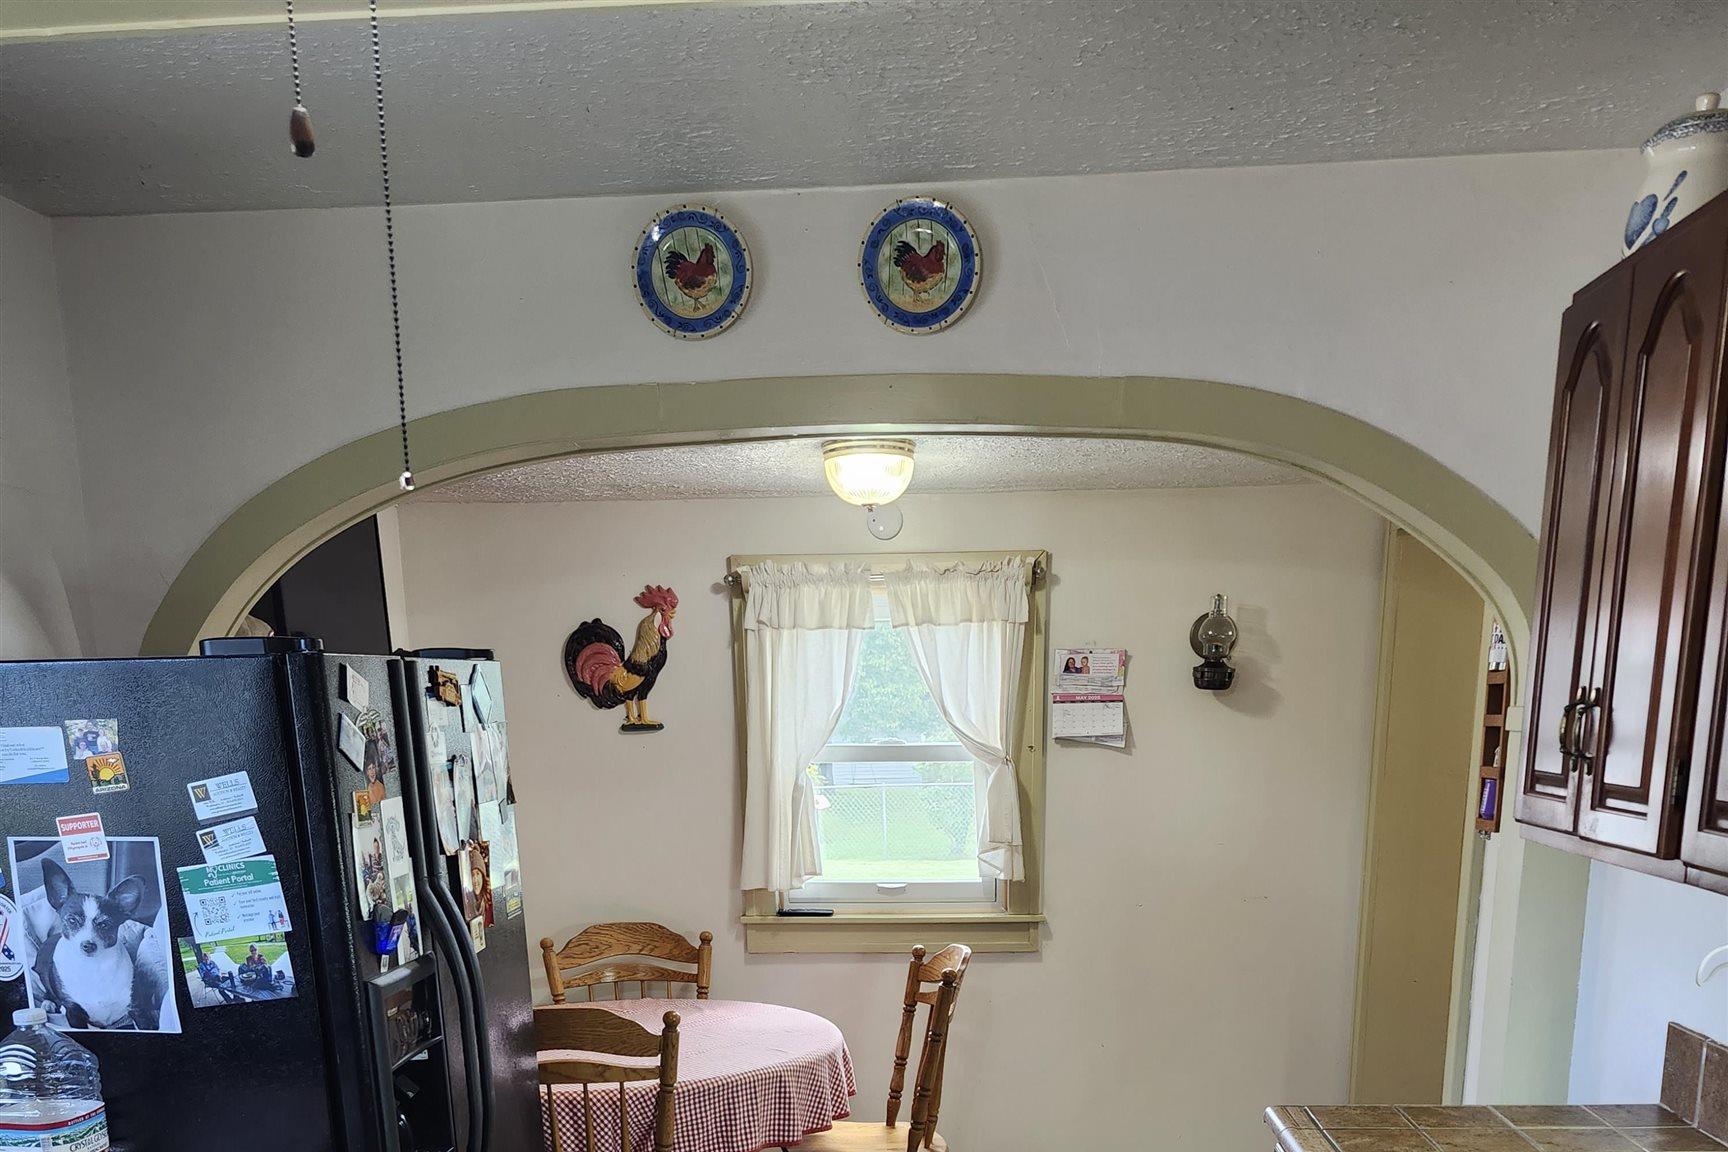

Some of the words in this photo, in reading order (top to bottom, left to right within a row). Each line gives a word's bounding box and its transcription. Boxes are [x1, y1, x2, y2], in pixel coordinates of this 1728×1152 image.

[95, 784, 127, 793] ARIZONA
[216, 779, 240, 789] WELLS
[195, 788, 206, 799] W
[61, 820, 99, 832] SUPPORTER
[223, 824, 247, 834] WELLS
[204, 878, 230, 886] Patient
[231, 874, 254, 883] Portal
[70, 1138, 94, 1152] CRYSTAL
